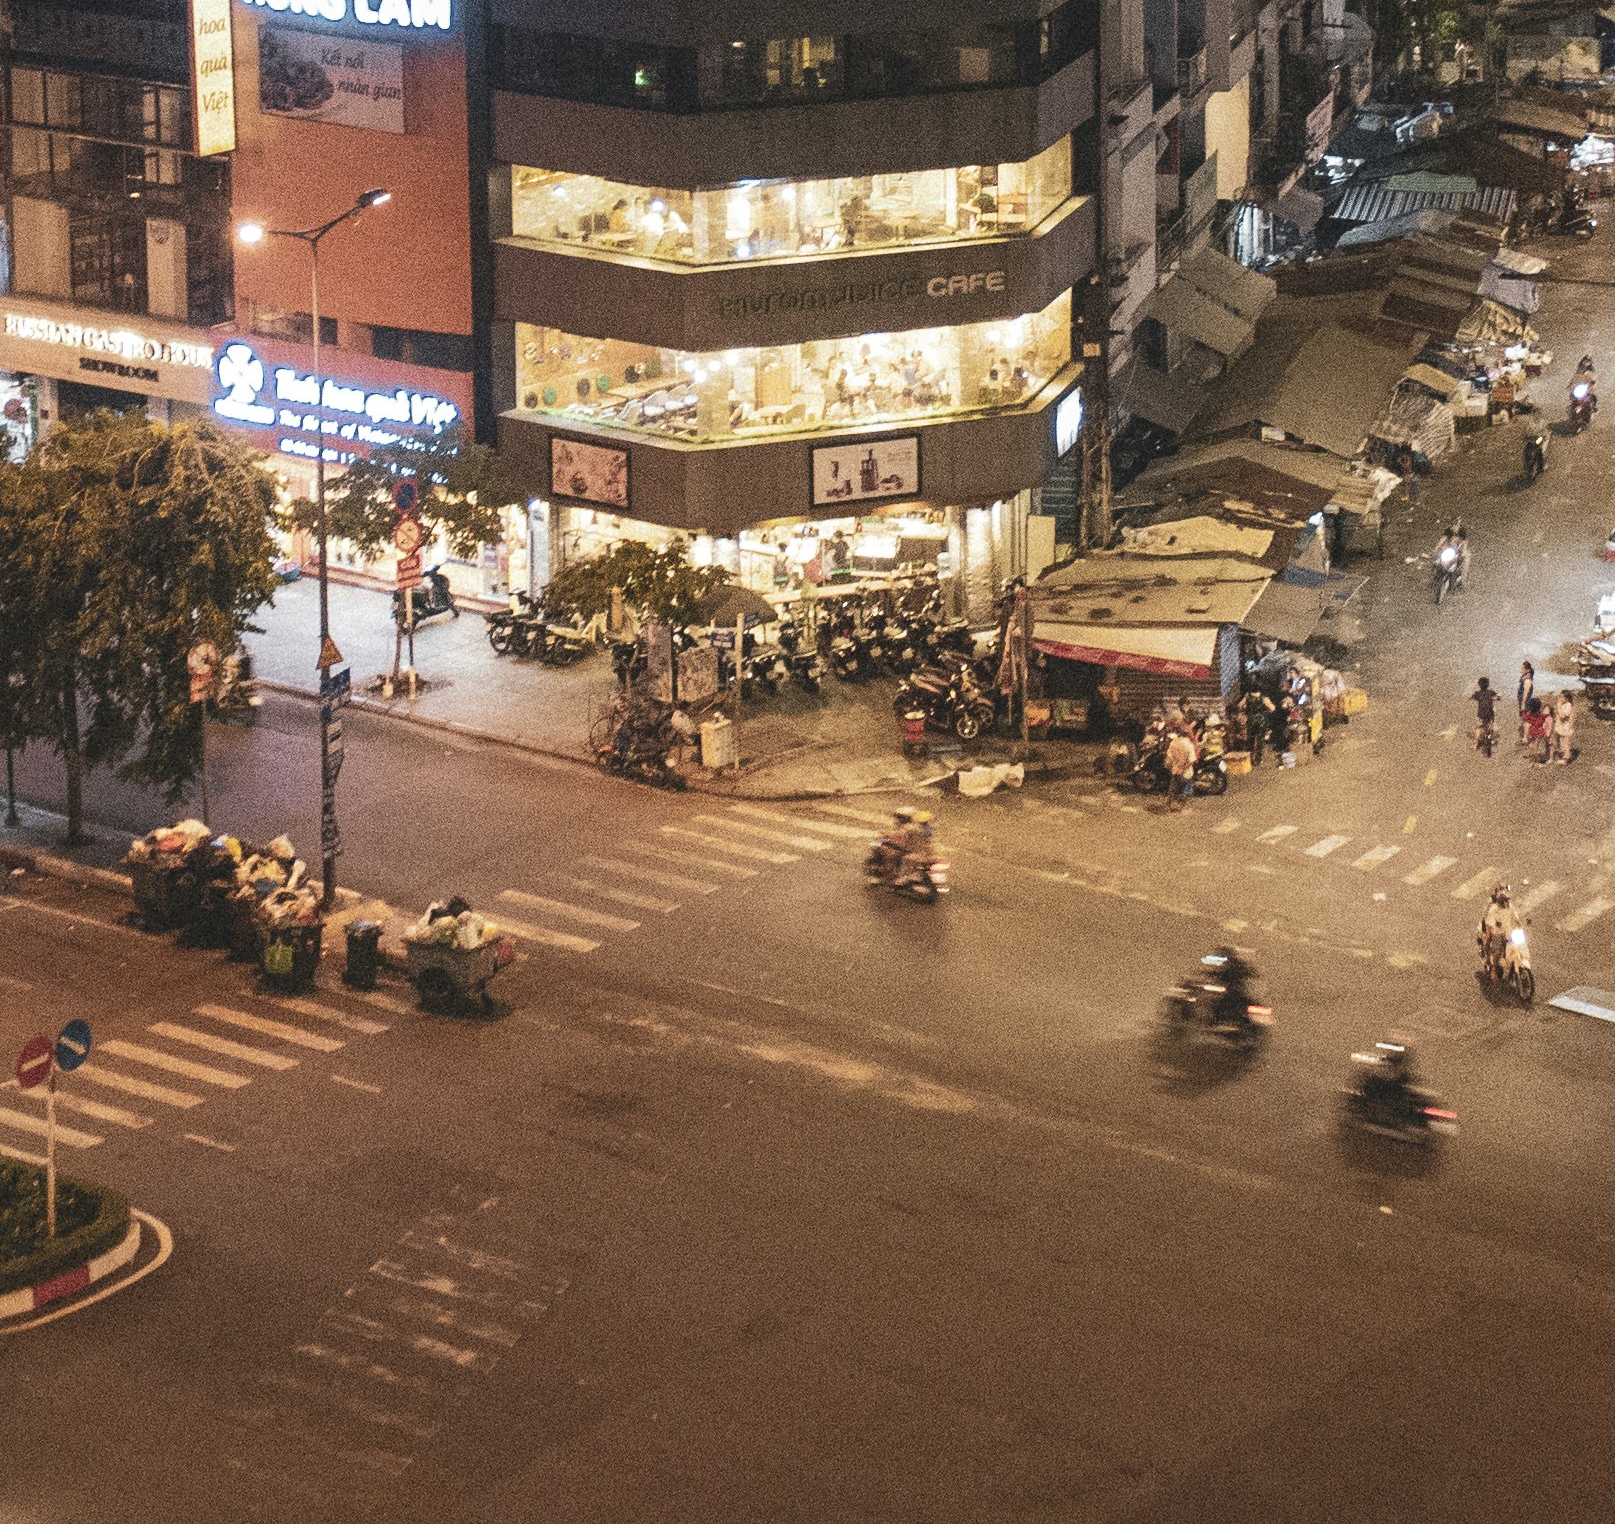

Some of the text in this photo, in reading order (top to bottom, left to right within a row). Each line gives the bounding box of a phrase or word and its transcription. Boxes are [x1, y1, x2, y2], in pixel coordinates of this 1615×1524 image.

[198, 17, 226, 36] hoa
[200, 54, 228, 78] quà
[202, 93, 229, 114] Việt
[926, 270, 1007, 298] CAFE
